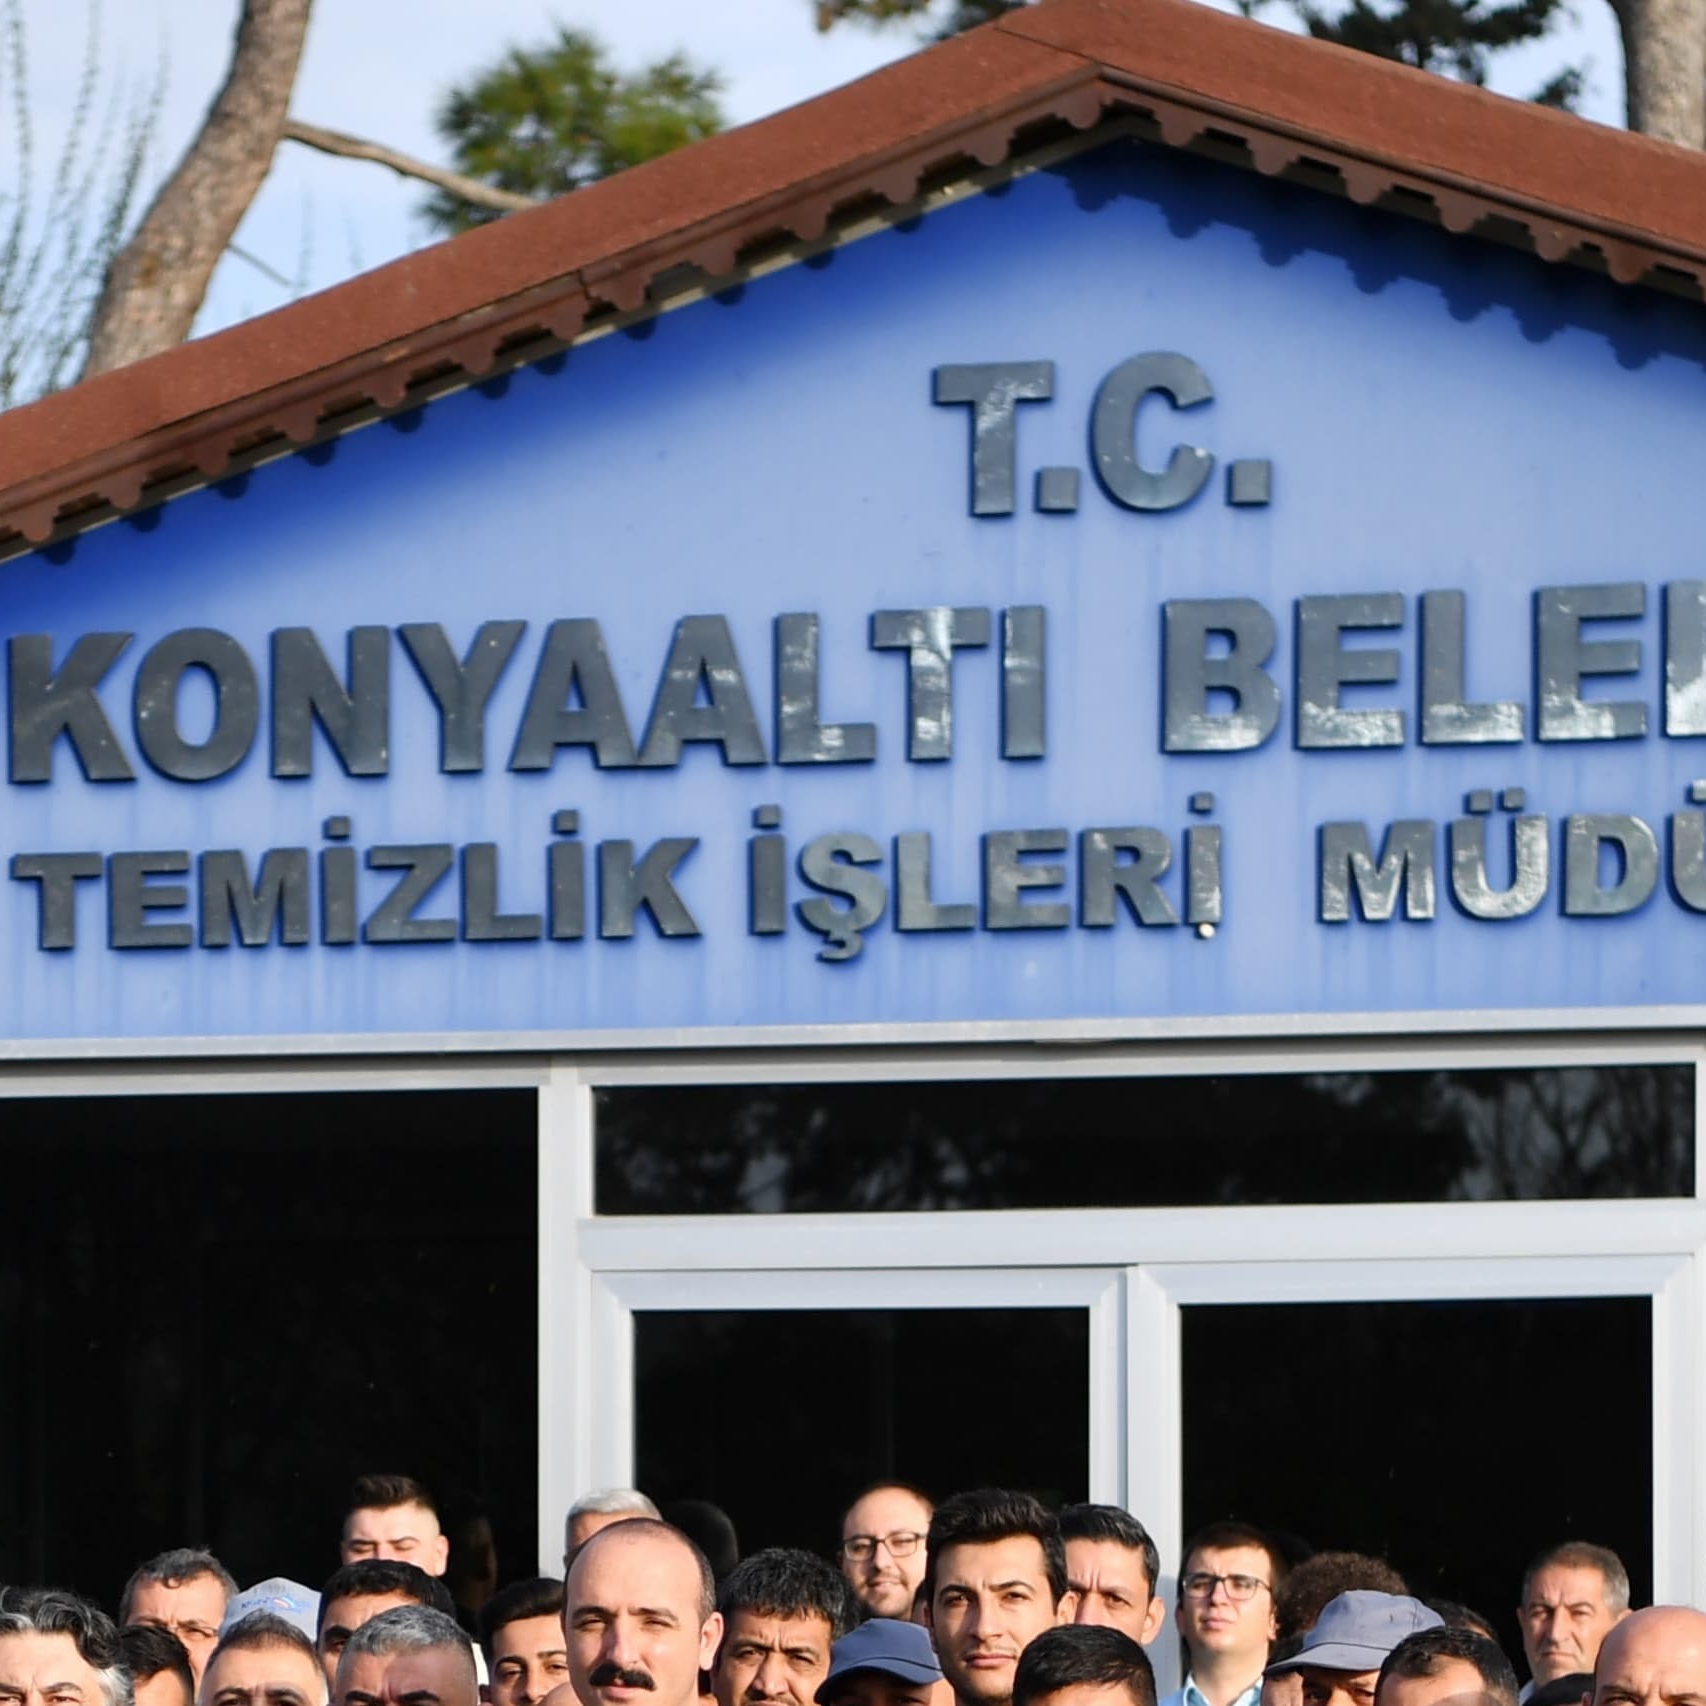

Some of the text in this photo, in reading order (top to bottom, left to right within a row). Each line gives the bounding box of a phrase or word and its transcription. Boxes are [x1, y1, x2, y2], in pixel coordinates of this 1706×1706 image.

[931, 350, 1272, 518] T.C.
[7, 605, 1046, 785] KONYAALTI
[10, 808, 703, 951] TEMİZLİK
[749, 791, 1223, 963] İŞLERİ
